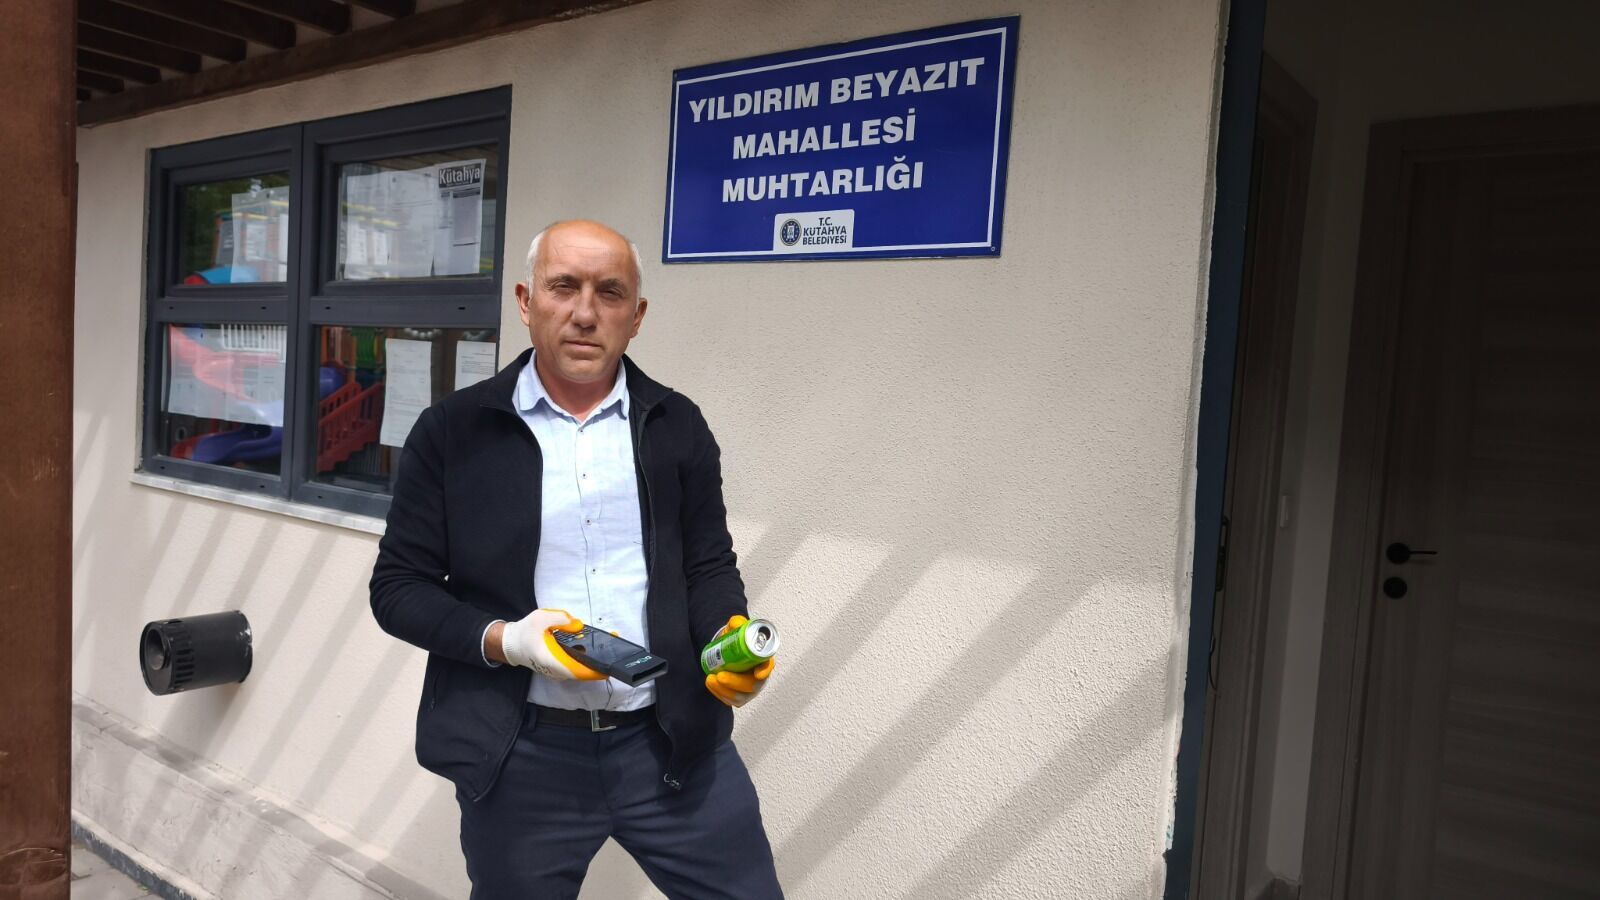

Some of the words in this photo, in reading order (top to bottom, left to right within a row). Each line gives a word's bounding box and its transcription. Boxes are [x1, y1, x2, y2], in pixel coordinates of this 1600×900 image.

[689, 81, 820, 123] YILDIRIM
[830, 57, 985, 105] BEYAZIT
[732, 108, 916, 160] MAHALLESİ
[439, 166, 481, 185] Kütahya
[722, 155, 924, 203] MUHTARLIĞI
[803, 225, 847, 236] KÜTAHYA
[818, 216, 833, 226] T.C.
[802, 235, 847, 245] BELEDİYESİ
